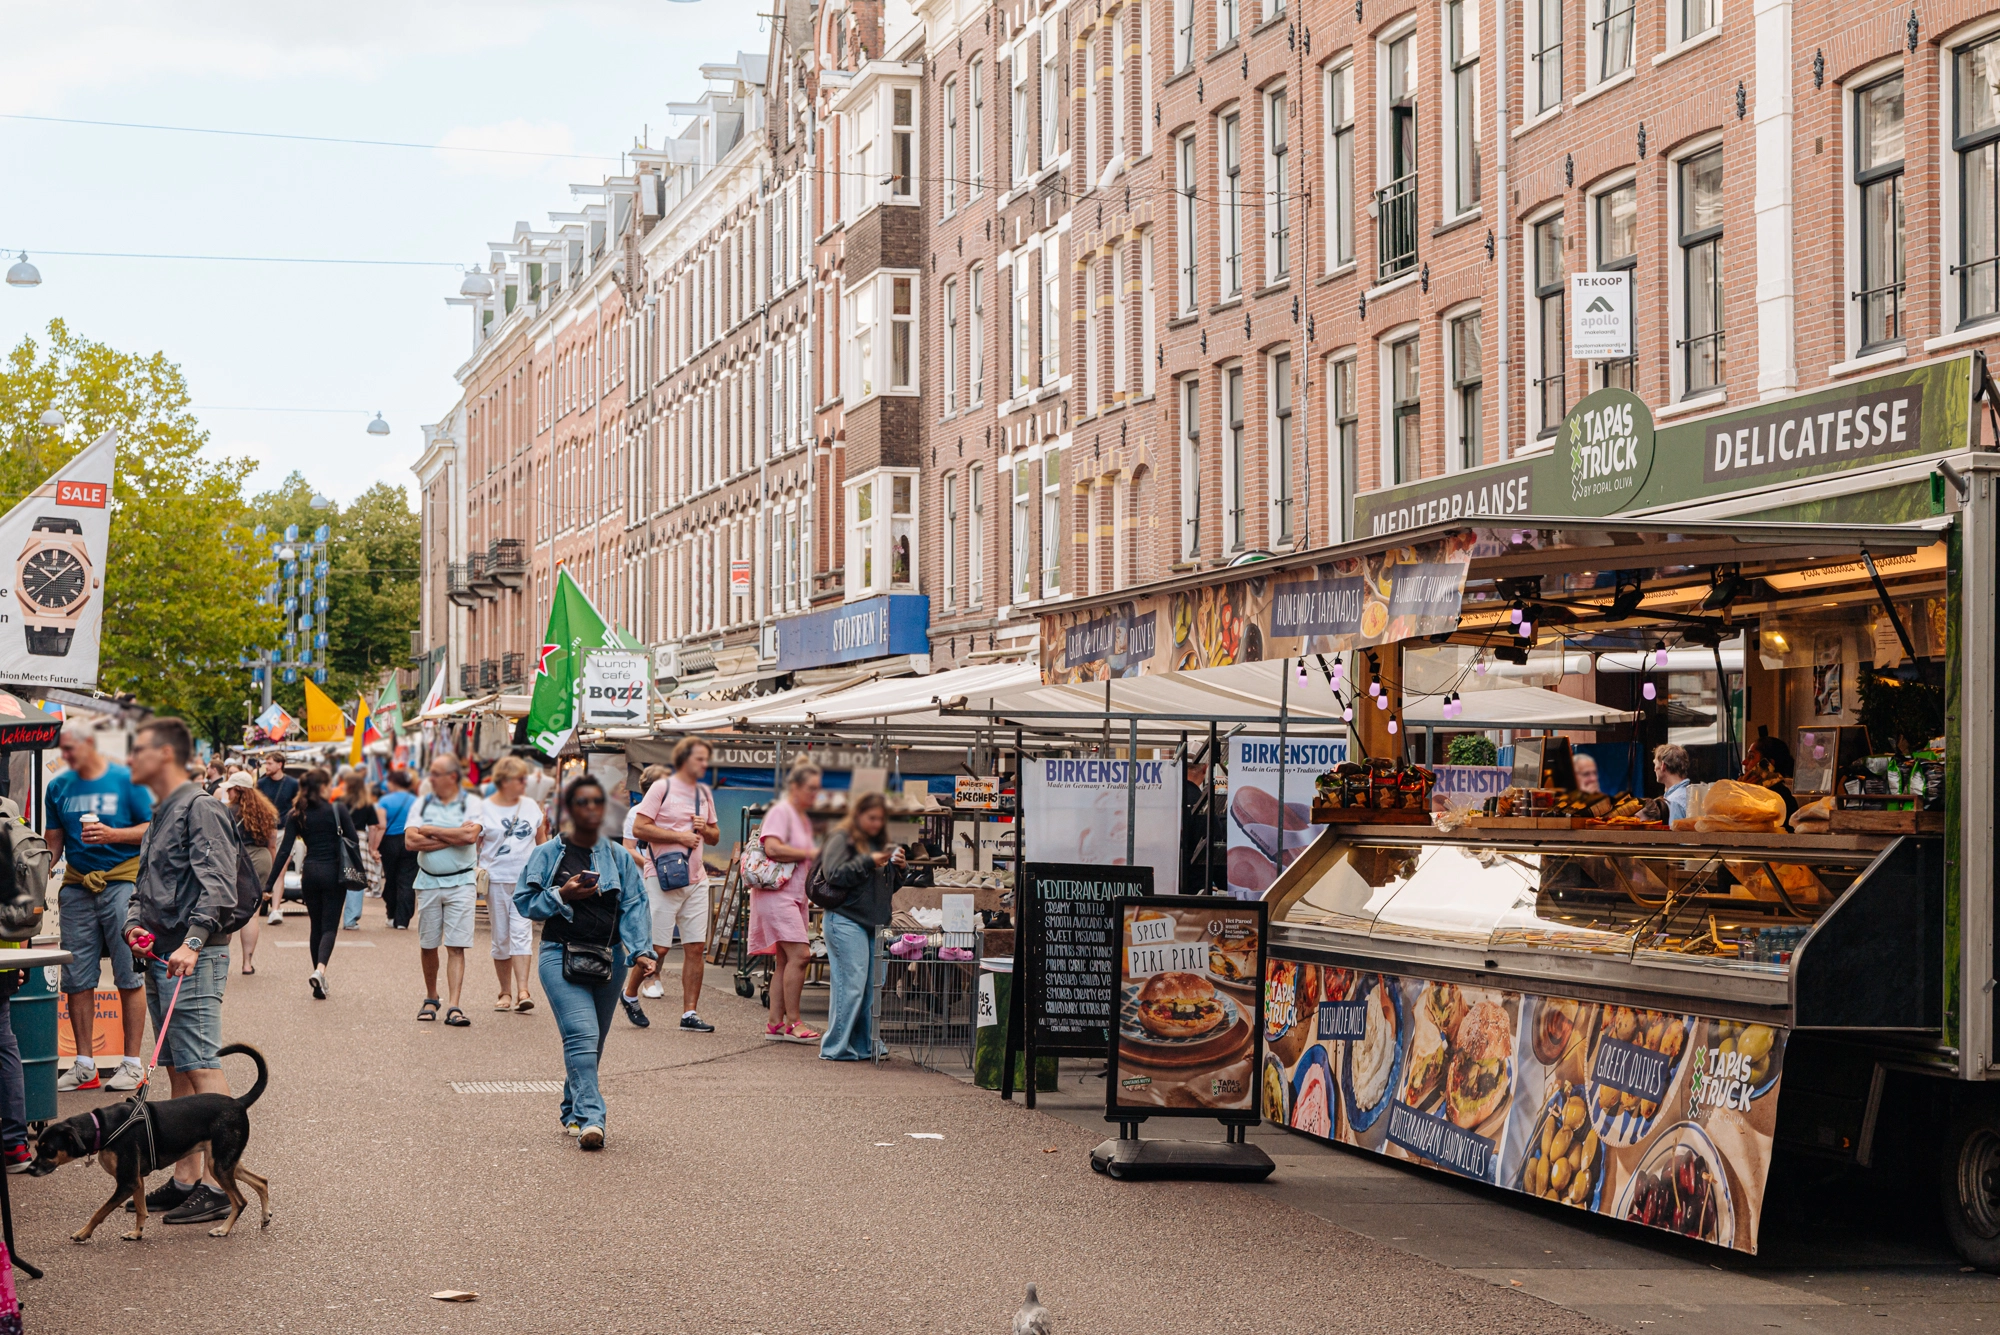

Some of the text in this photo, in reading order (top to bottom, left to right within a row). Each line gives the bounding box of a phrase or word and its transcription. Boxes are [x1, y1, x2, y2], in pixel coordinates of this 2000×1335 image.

[1577, 278, 1590, 287] TE
[1591, 277, 1623, 287] KOOP
[1581, 314, 1620, 328] apollo
[1583, 403, 1634, 445] TAPAS
[1714, 398, 1909, 472] DELICATESSE
[1580, 435, 1639, 480] TRUCK
[61, 485, 102, 503] SALE
[1583, 476, 1633, 498] BY POPAL OLIVA
[1373, 475, 1529, 537] MEDITERRAANSE
[1316, 588, 1361, 624] TAPENADES
[833, 610, 877, 652] STOFFEN
[1129, 621, 1155, 656] OLIVES
[596, 659, 637, 669] Lunch
[21, 672, 48, 682] Meets
[49, 674, 79, 684] Future
[601, 670, 631, 680] café
[311, 723, 342, 733] MIKADO
[1241, 743, 1347, 765] BIRKENSTOCK
[956, 791, 998, 803] SKECHERS
[1072, 783, 1101, 791] Germany
[1036, 879, 1115, 901] MEDITERRANEAN
[1044, 902, 1071, 914] CREAMY
[1045, 916, 1072, 928] SMOOTH
[1073, 917, 1103, 929] AVOCADO
[1137, 922, 1167, 942] SPICY
[1045, 930, 1106, 943] SWEET PISTACHIO
[1045, 944, 1075, 957] HUMMUS
[1133, 947, 1204, 973] PIRI PIRI
[1045, 973, 1078, 986] SMASHED
[1046, 987, 1073, 1000] SMOKED
[1272, 981, 1296, 1006] TAPAS
[1269, 1001, 1298, 1027] TRUCK
[1596, 1043, 1664, 1096] GREEK OLIVES
[1708, 1048, 1753, 1083] TAPAS
[1216, 1085, 1242, 1094] TRUCK
[1699, 1075, 1755, 1112] TRUCK
[1388, 1105, 1489, 1177] MEDITERRANEAN SANDWICHES
